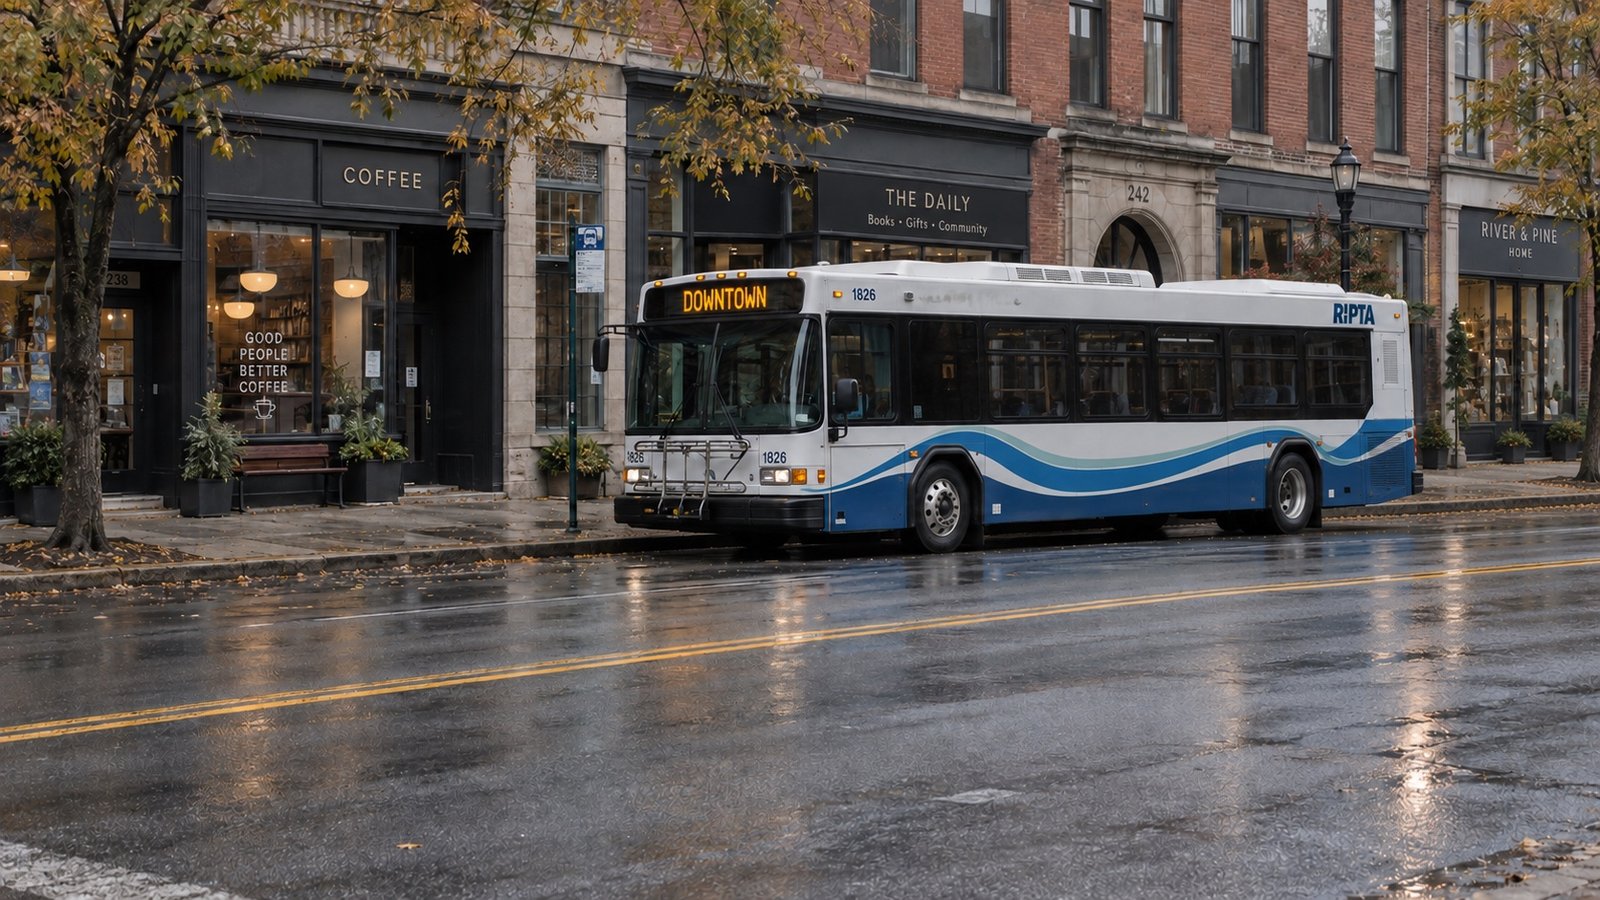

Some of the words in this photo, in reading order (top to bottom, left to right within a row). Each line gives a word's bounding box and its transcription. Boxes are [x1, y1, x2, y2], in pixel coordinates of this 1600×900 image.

[343, 166, 422, 189] COFFEE
[885, 188, 917, 208] THE
[925, 192, 970, 212] DAILY
[1128, 184, 1149, 203] 242
[868, 213, 895, 227] Books
[906, 217, 928, 230] Gifts
[938, 220, 988, 237] Community
[1481, 221, 1516, 240] RIVER
[1520, 226, 1528, 242] &
[1532, 227, 1557, 244] PINE
[1508, 247, 1533, 259] HOME
[106, 273, 129, 286] 238
[683, 285, 767, 313] DOWNTOWN
[852, 287, 876, 301] 1826
[245, 331, 283, 344] GOOD
[240, 348, 288, 361] PEOPLE
[240, 364, 288, 377] BETTER
[239, 381, 288, 393] COFFEE
[763, 451, 787, 464] 1826
